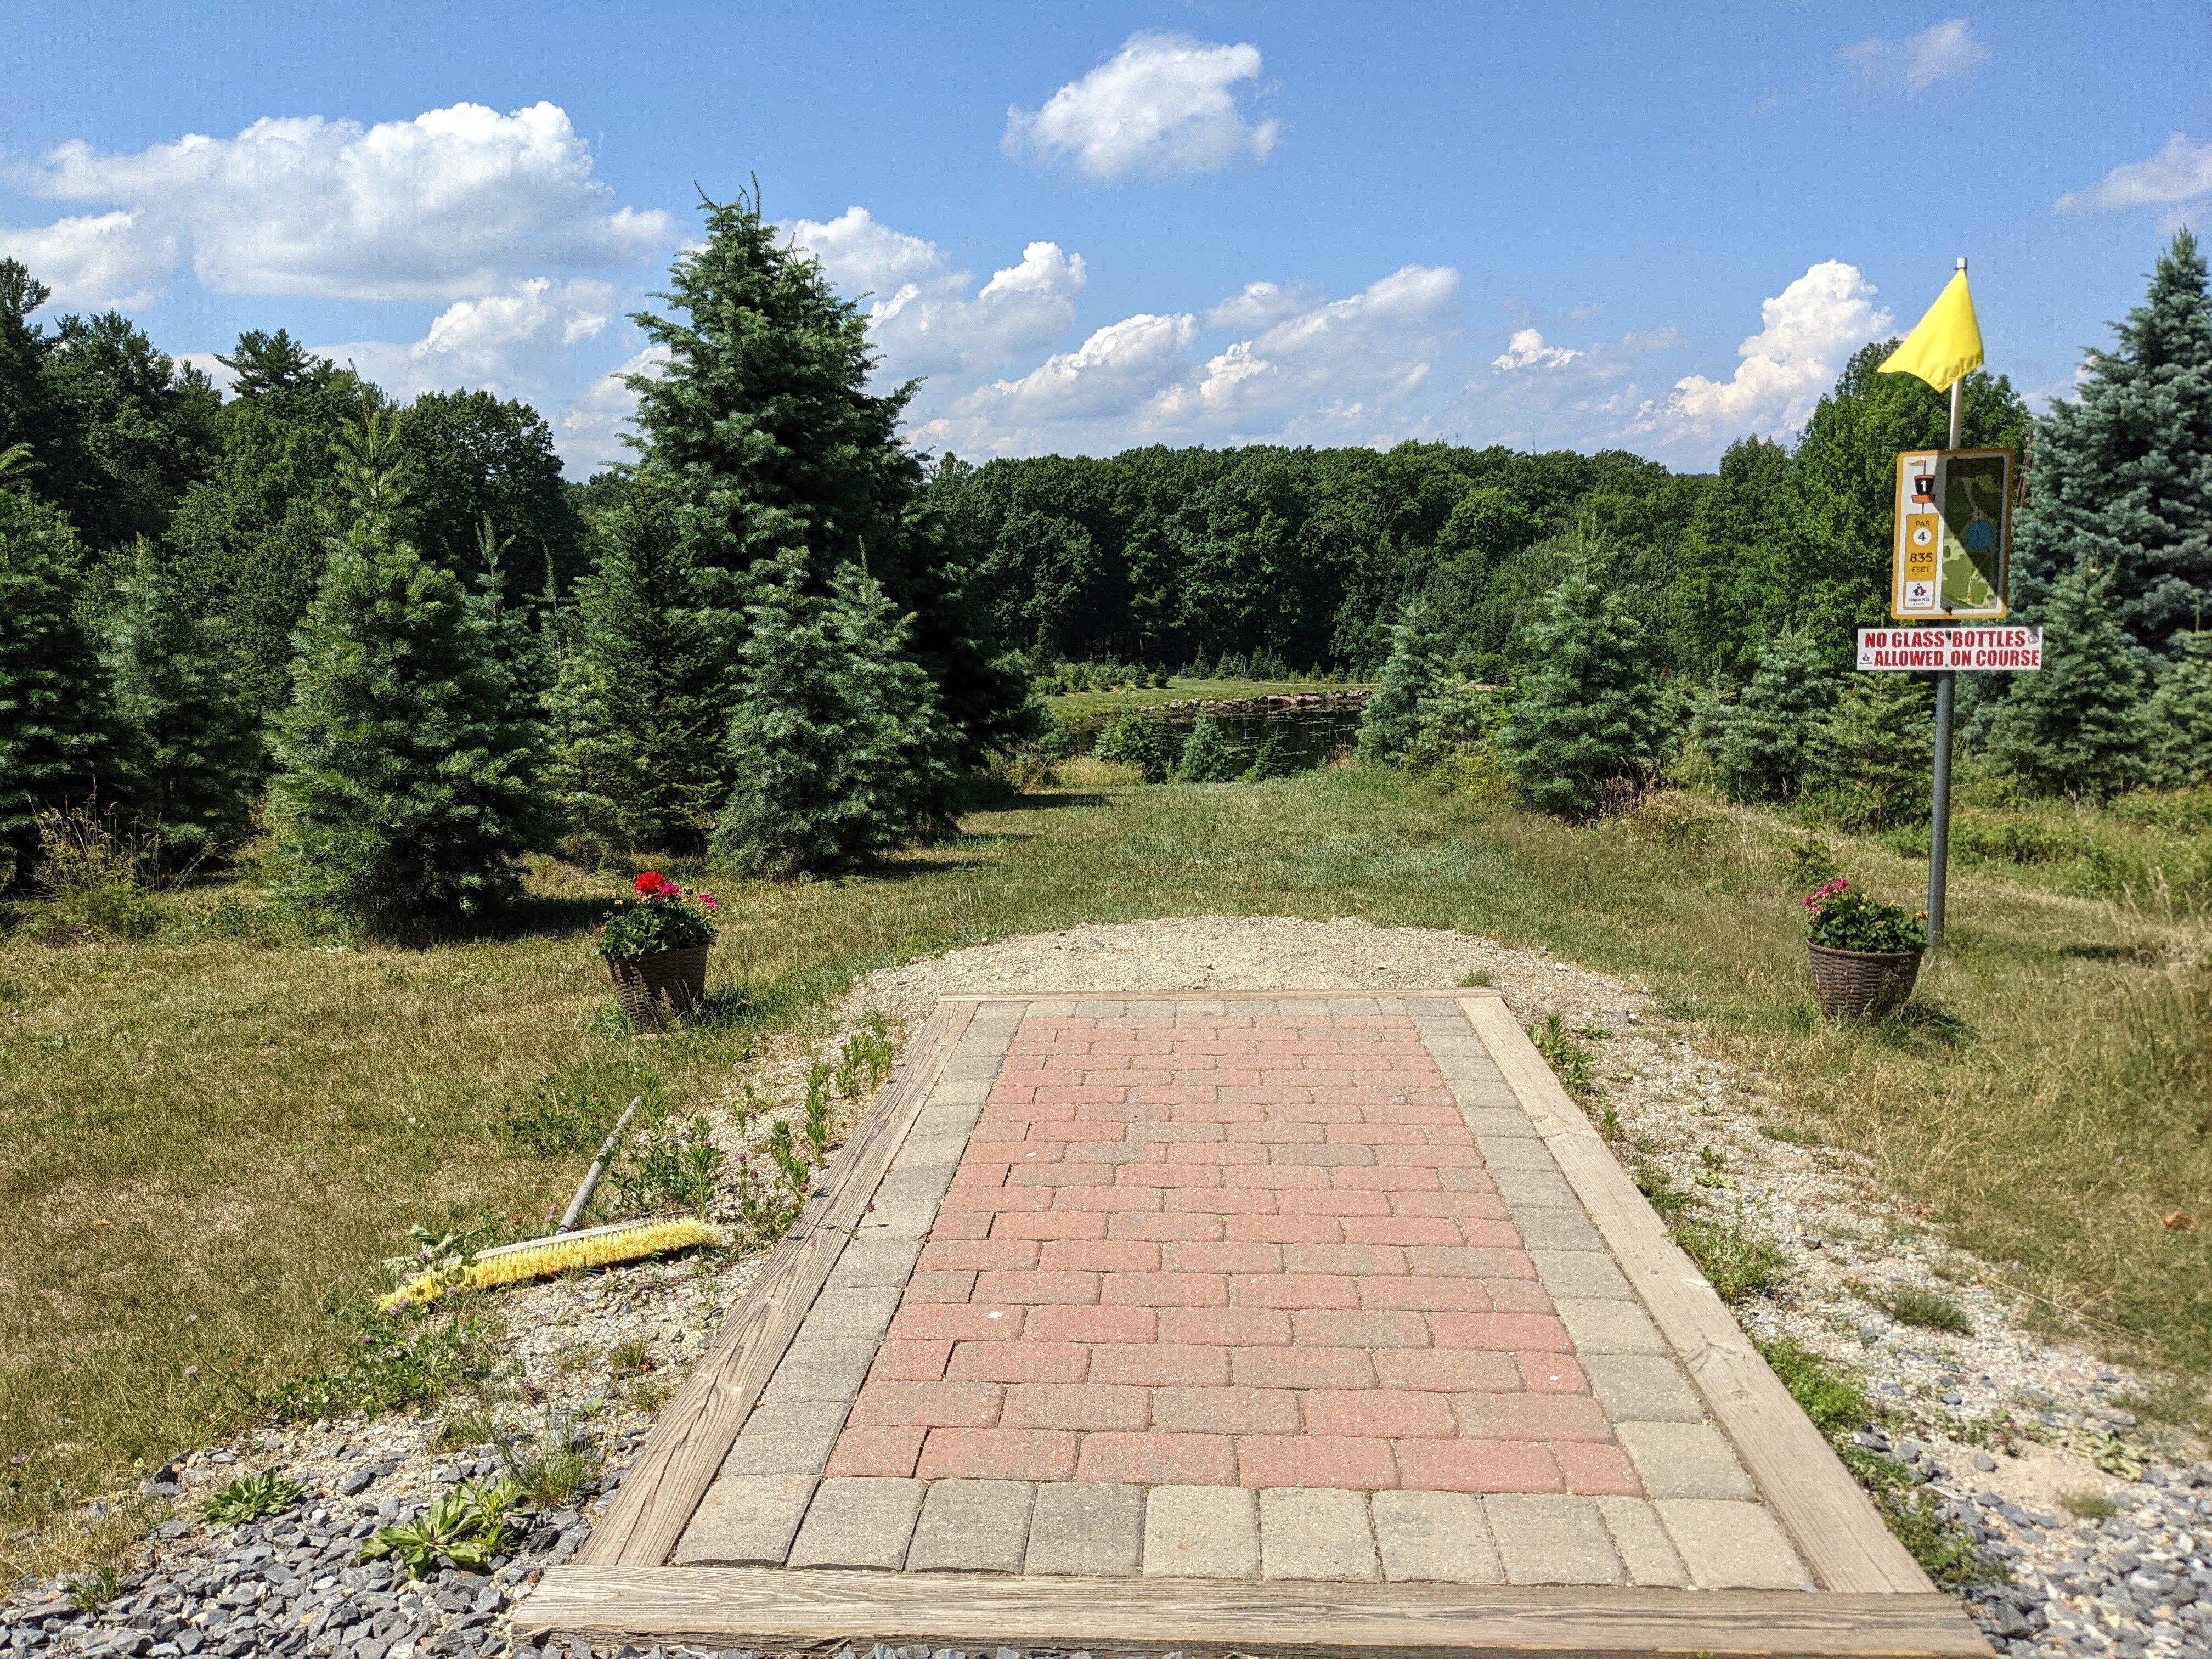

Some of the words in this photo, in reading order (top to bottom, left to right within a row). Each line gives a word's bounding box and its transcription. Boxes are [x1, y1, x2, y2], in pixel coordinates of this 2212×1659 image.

[1920, 479, 1927, 492] 1
[1918, 532, 1926, 541] 4
[1910, 552, 1933, 563] 835
[1865, 631, 1887, 648] NO
[1892, 631, 1945, 648] GLASS
[1952, 630, 2025, 647] BOTTLES
[1874, 650, 1944, 667] ALLOWED
[1950, 650, 1972, 666] ON
[1976, 650, 2039, 667] COURSE
